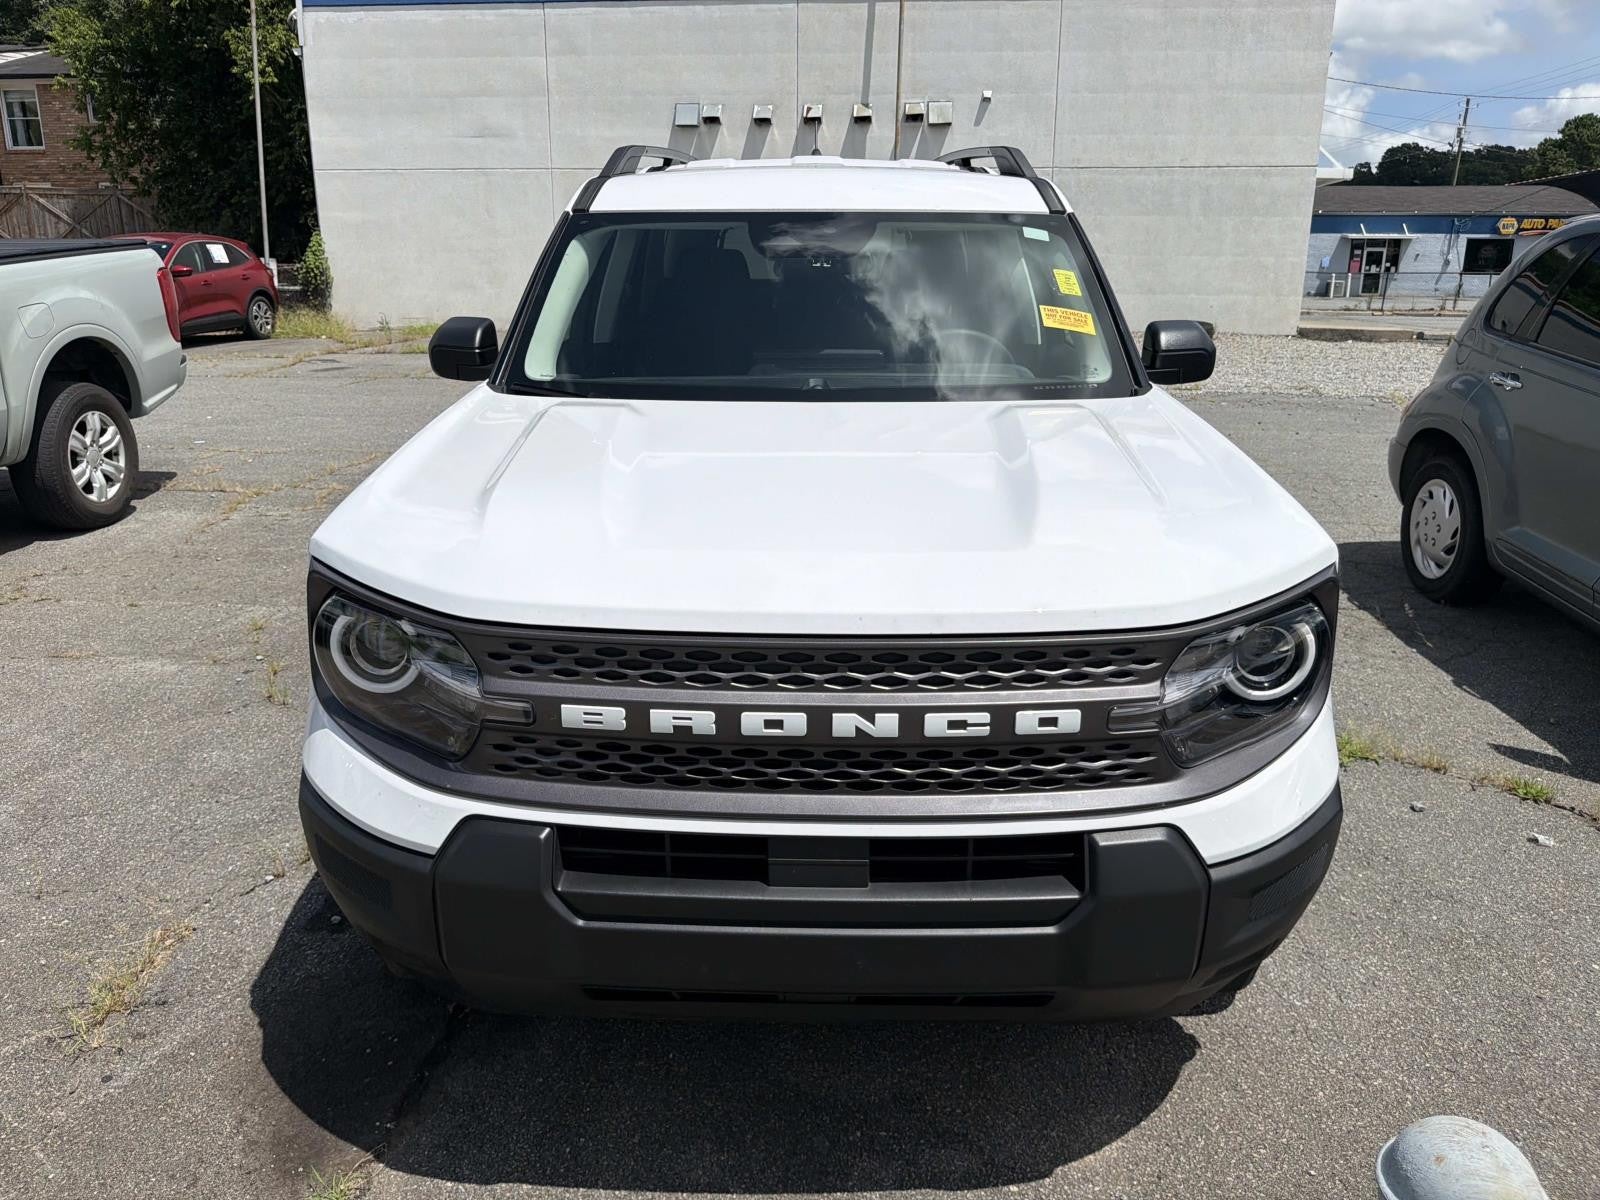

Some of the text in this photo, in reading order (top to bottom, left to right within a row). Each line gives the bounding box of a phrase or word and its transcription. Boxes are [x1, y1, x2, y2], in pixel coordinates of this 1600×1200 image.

[1520, 218, 1569, 229] AUTO PAR
[1060, 309, 1089, 320] VEHICLE
[560, 703, 1082, 737] BRONCO
